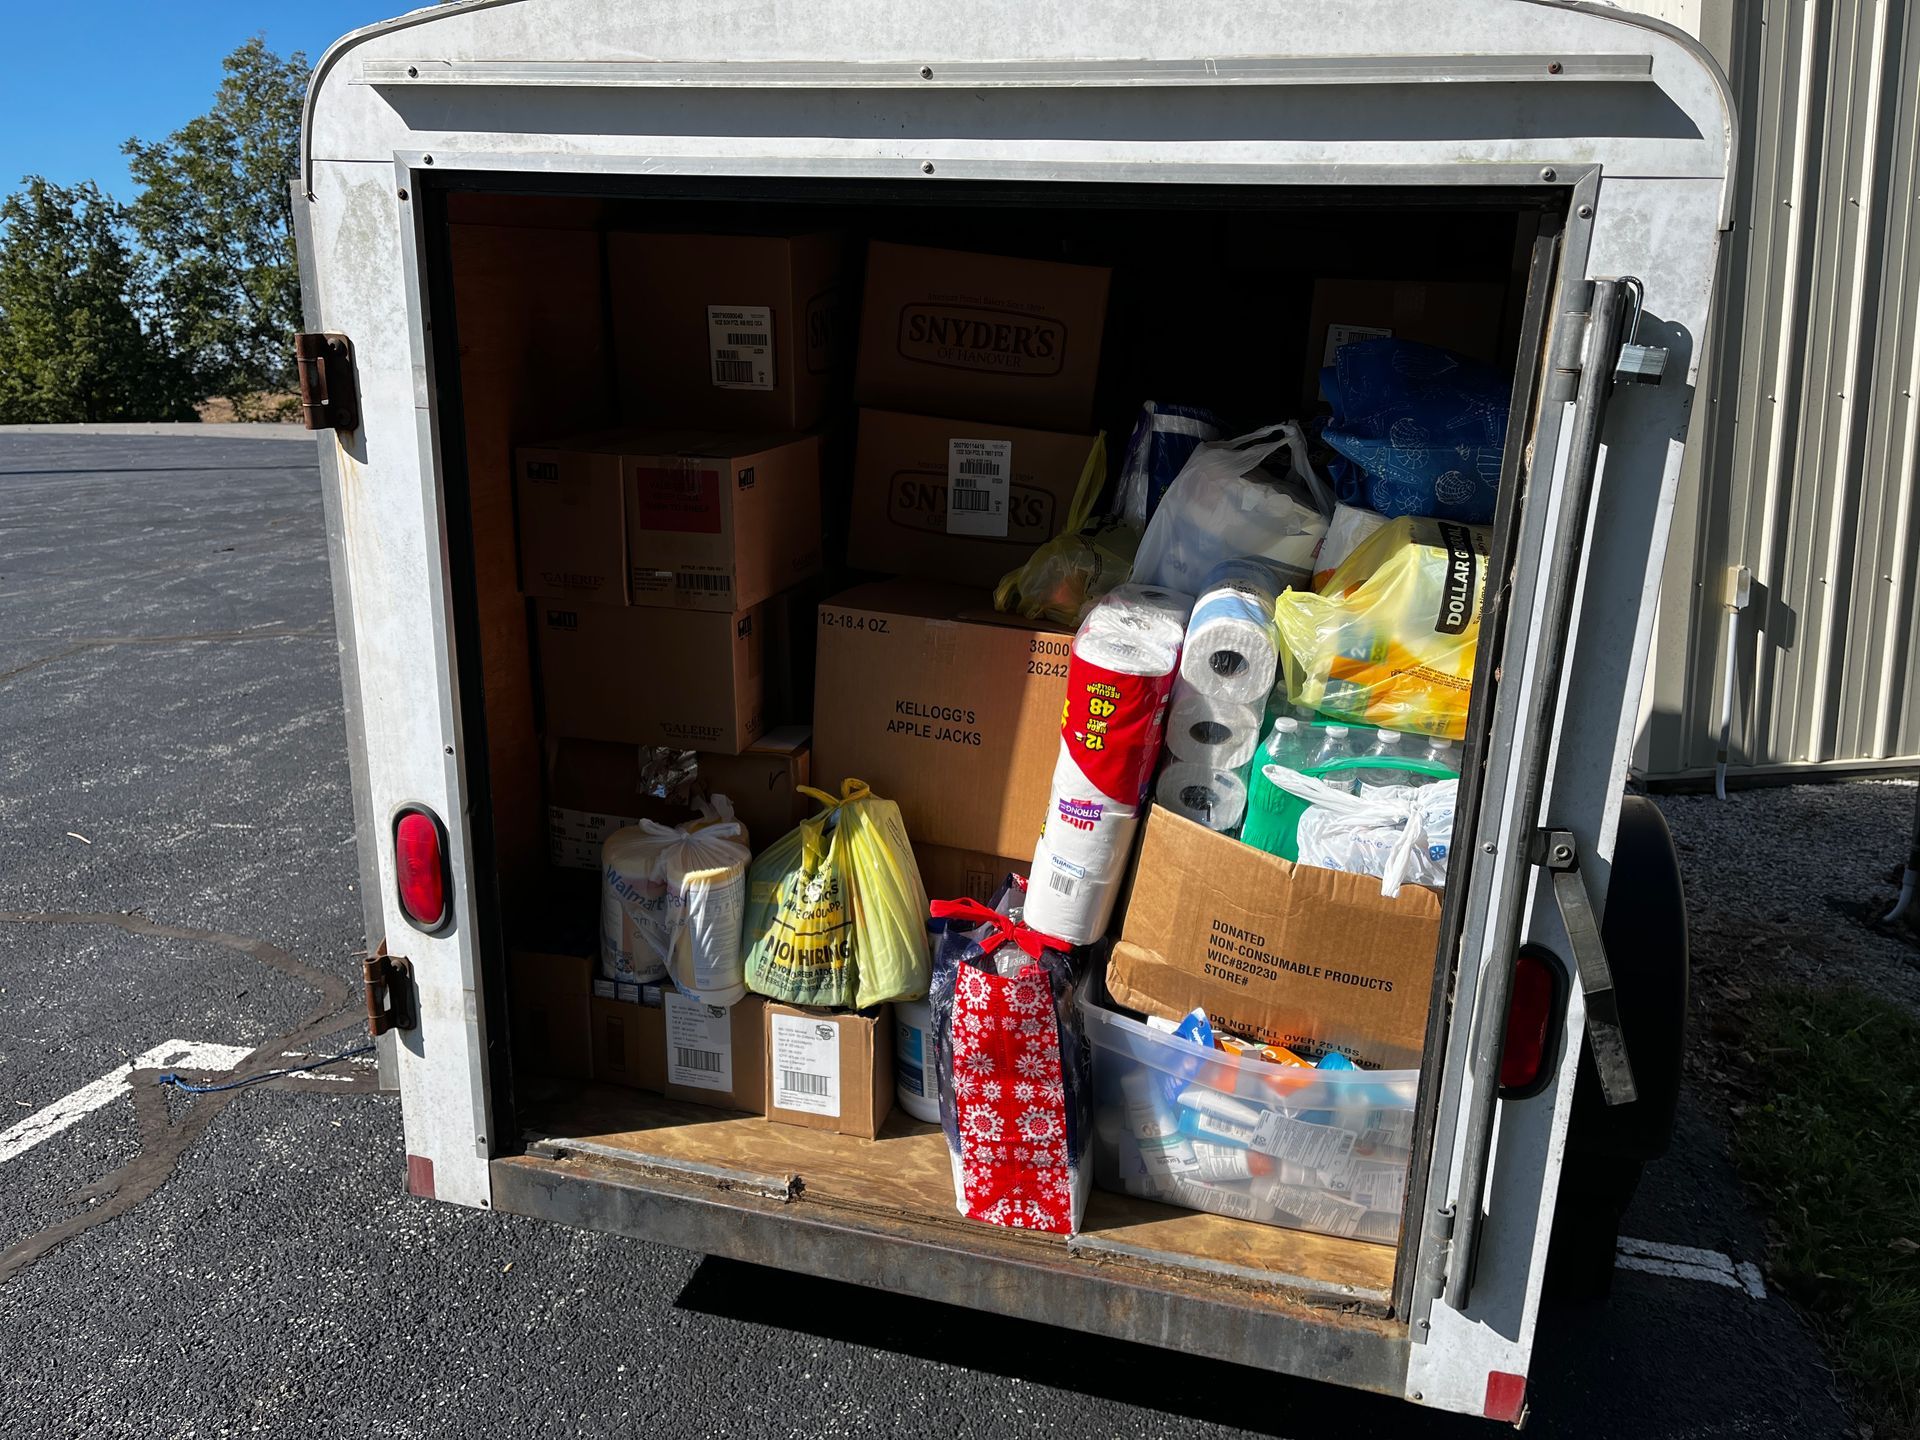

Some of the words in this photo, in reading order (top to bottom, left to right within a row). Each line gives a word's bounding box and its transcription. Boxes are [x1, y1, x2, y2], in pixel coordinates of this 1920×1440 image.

[937, 347, 952, 360] OF
[957, 349, 1022, 368] HANOVER
[1446, 561, 1470, 626] DOLLAR
[820, 612, 865, 630] 12-18.4
[868, 618, 891, 634] OZ.
[1029, 639, 1070, 657] 38000
[1027, 660, 1068, 678] 26242
[1086, 684, 1121, 699] REGULAR
[896, 700, 975, 724] KELLOGG'S
[1089, 697, 1116, 718] 48
[886, 719, 931, 738] APPLE
[934, 728, 981, 746] JACKS
[1085, 733, 1104, 751] 12
[1065, 804, 1100, 818] STRONG
[1060, 813, 1095, 832] Ultra
[606, 864, 665, 912] Walmart
[667, 892, 688, 908] Pay
[1212, 919, 1265, 947] DONATED
[800, 939, 851, 967] HIRING
[1209, 933, 1321, 978] NON-CONSUMABLE
[1324, 969, 1393, 992] PRODUCTS
[1204, 963, 1249, 986] STORE#
[1207, 949, 1277, 981] WIC#820230
[1210, 1013, 1226, 1026] DO
[1229, 1018, 1252, 1032] NOT
[1256, 1026, 1280, 1039] FILL
[1284, 1034, 1317, 1046] OVER
[1319, 1040, 1334, 1049] 25
[1336, 1045, 1364, 1058] LBS.
[1268, 1038, 1312, 1052] INCHES
